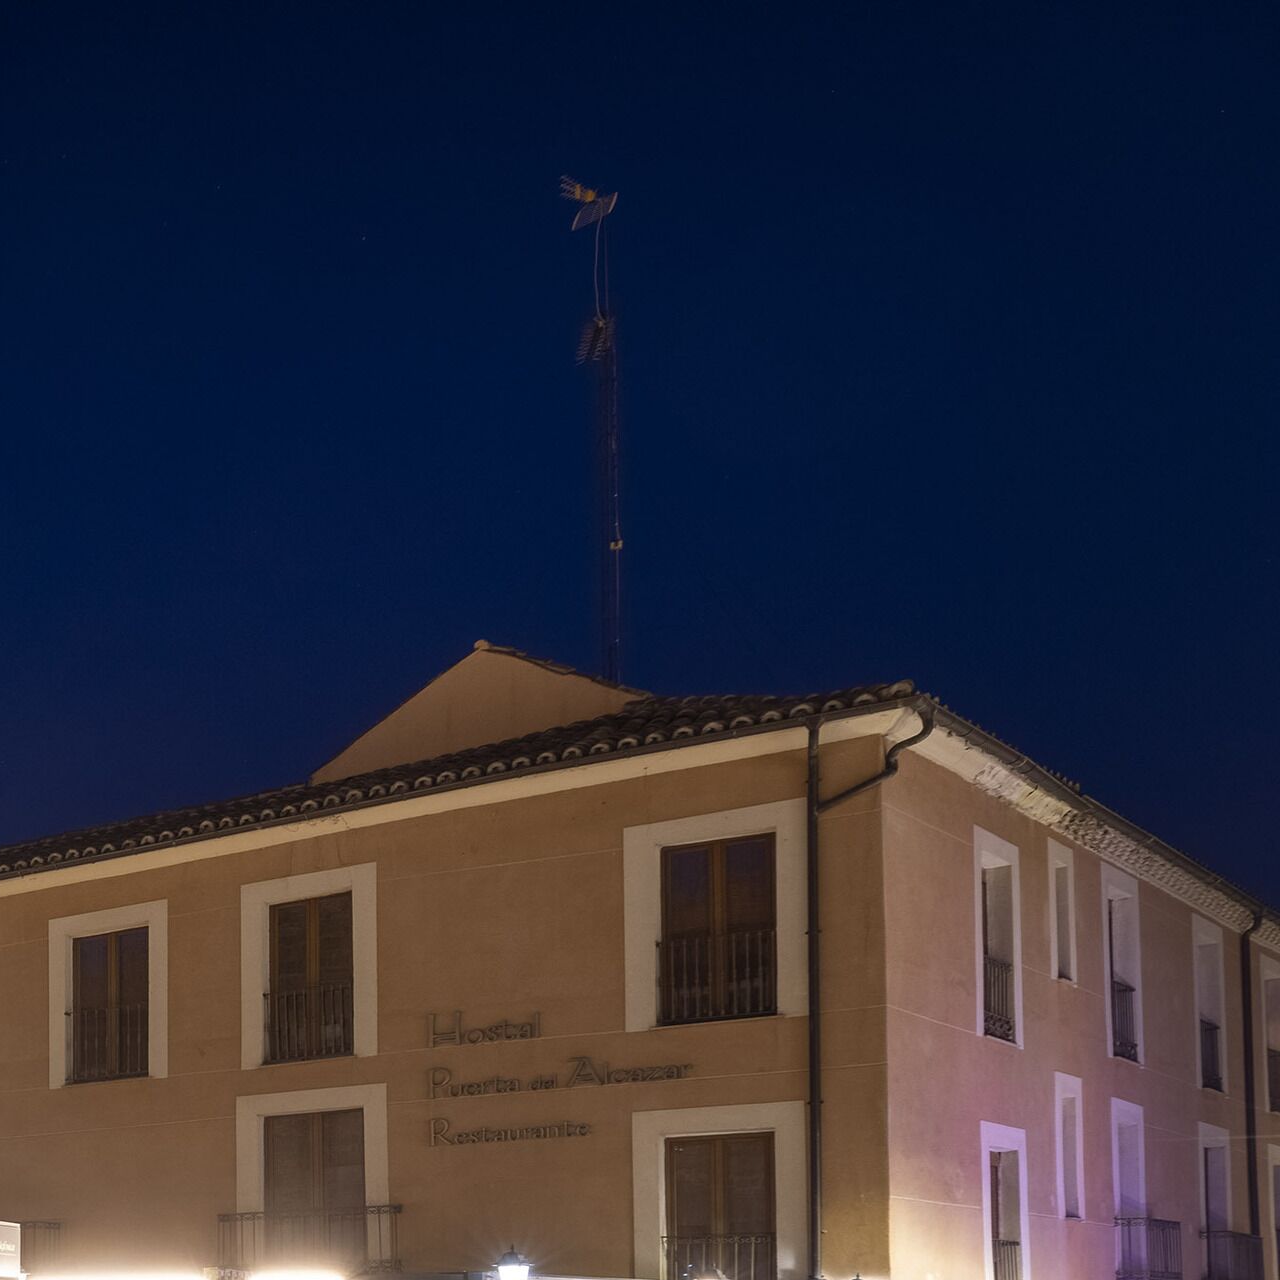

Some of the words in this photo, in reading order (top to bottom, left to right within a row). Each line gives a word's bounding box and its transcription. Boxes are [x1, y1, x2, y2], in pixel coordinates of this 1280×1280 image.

[426, 1011, 542, 1048] Hostal
[427, 1067, 520, 1099] Puerta
[528, 1073, 558, 1090] del
[567, 1056, 693, 1087] Alcazar
[428, 1118, 592, 1147] Restaurante
